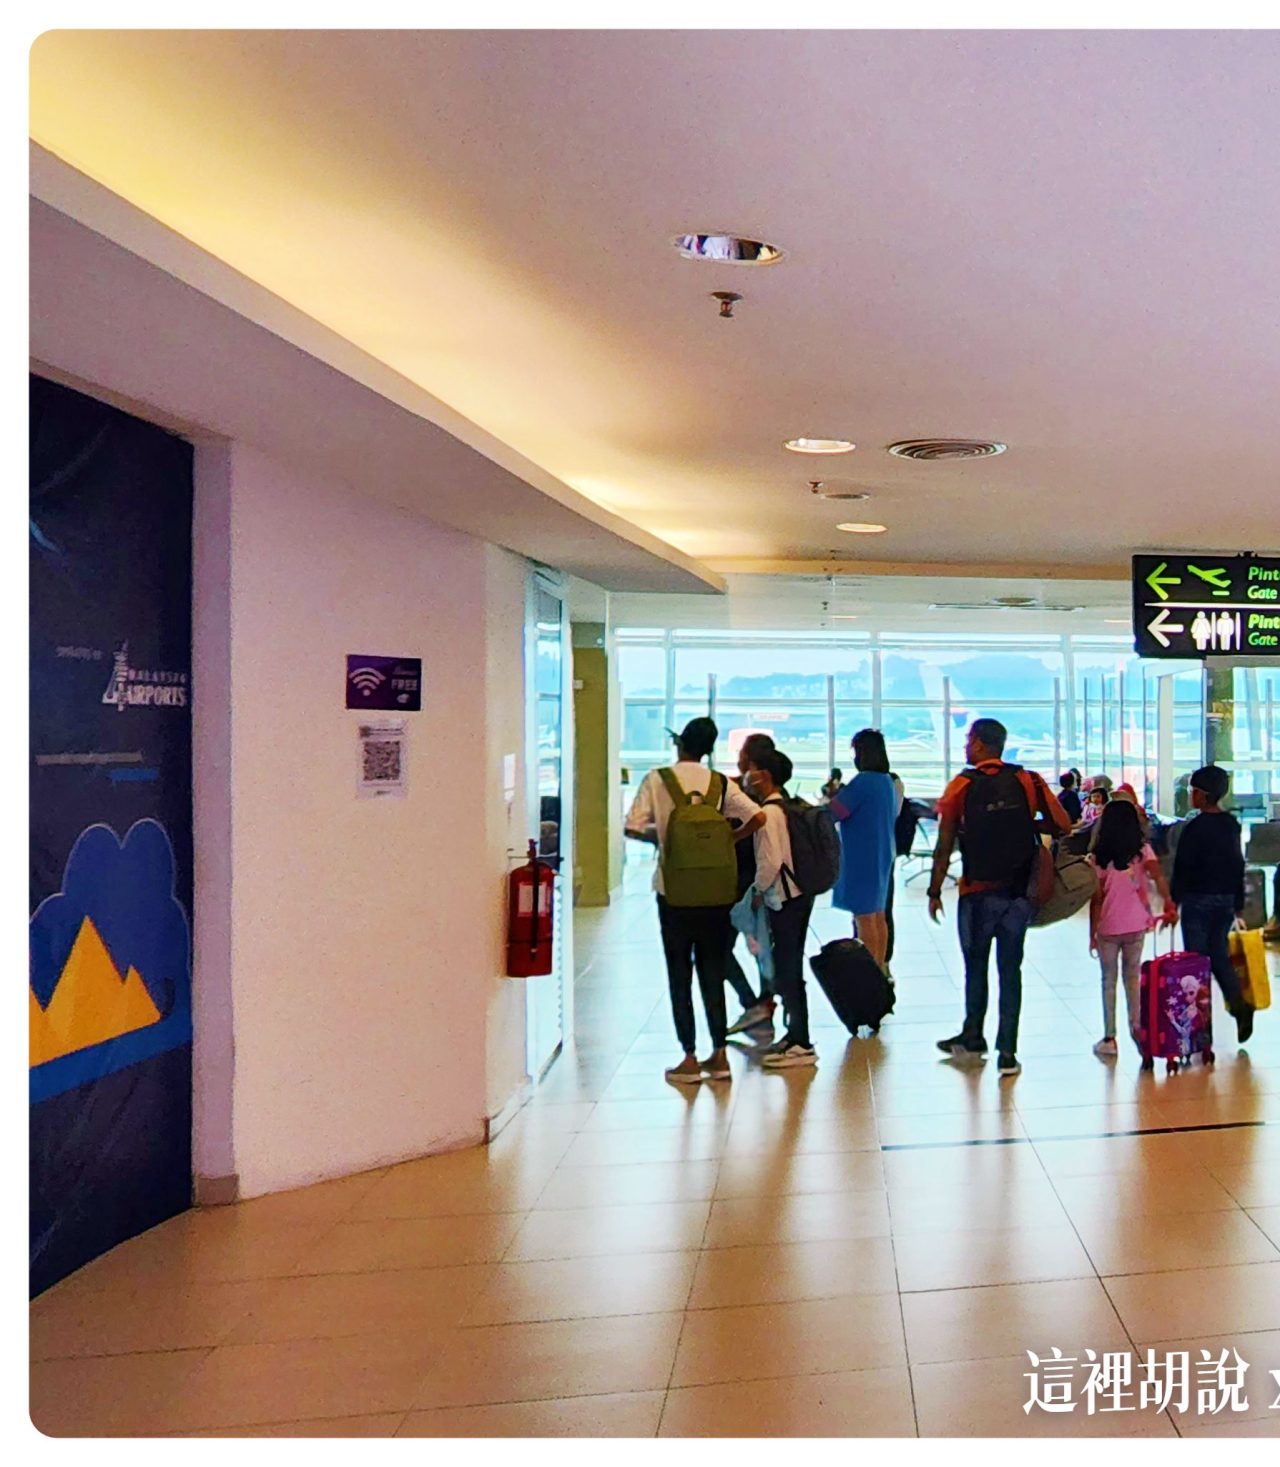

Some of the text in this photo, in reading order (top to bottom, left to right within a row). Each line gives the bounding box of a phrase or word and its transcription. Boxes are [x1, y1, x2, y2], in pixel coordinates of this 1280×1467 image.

[1247, 585, 1278, 600] Gate
[1248, 632, 1278, 646] Gate
[391, 679, 418, 690] FREE
[127, 684, 187, 706] AIRPORTS
